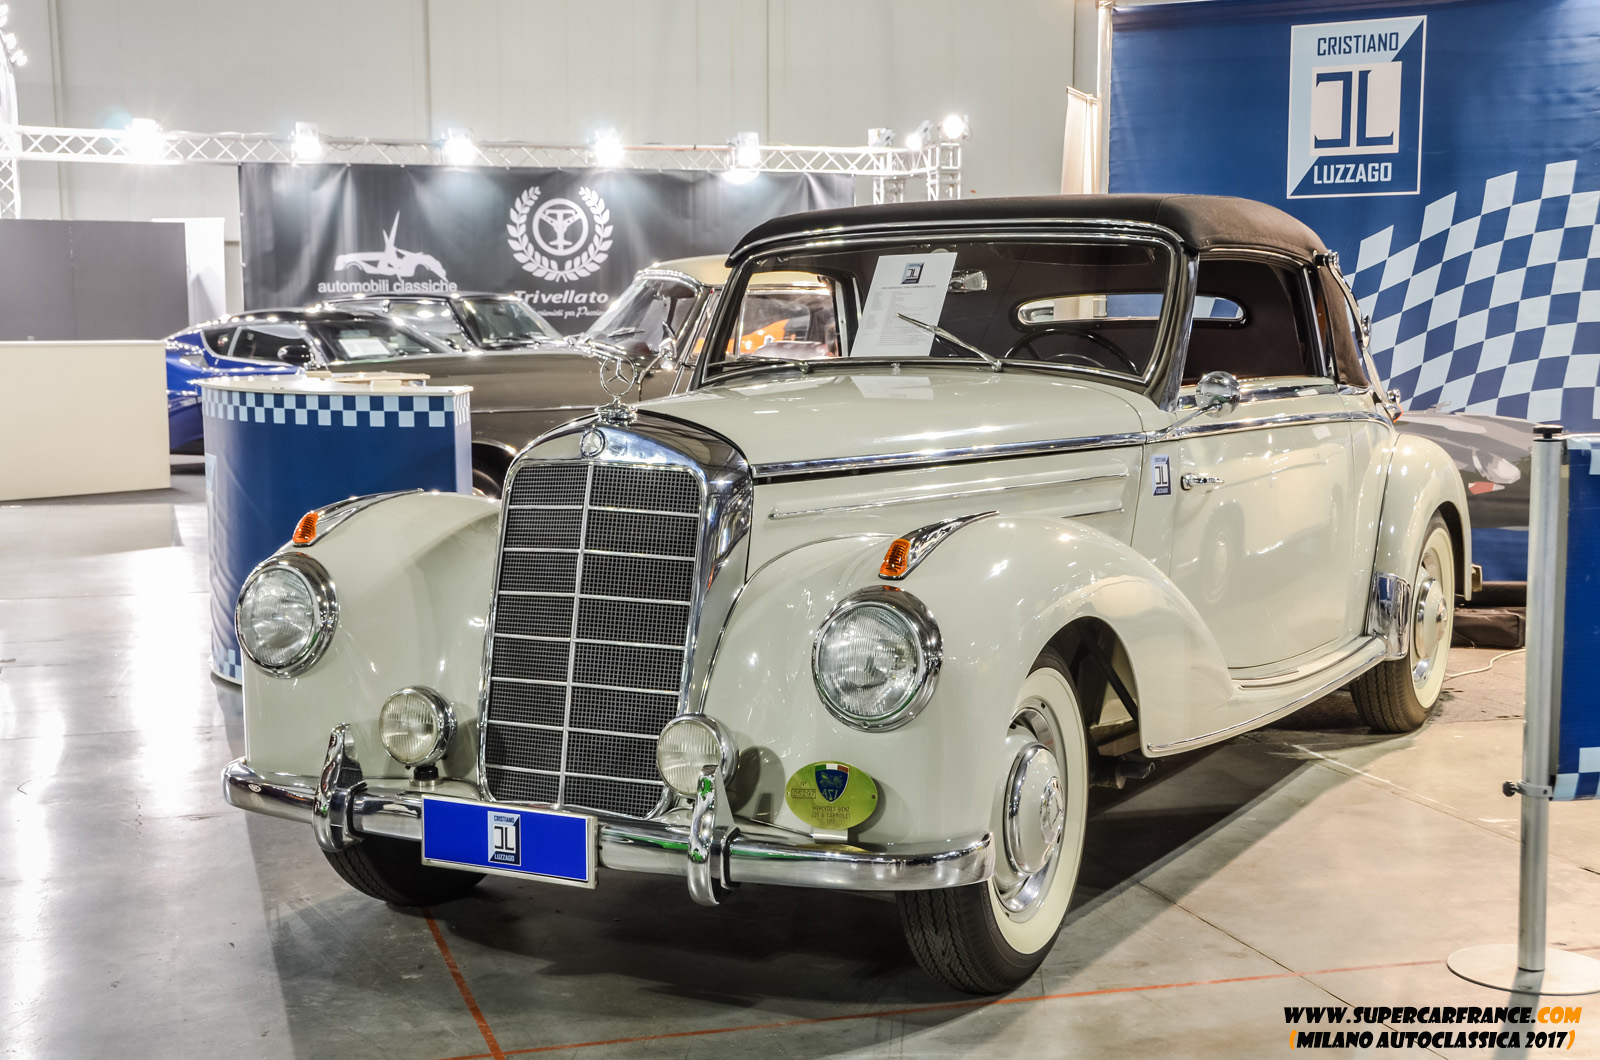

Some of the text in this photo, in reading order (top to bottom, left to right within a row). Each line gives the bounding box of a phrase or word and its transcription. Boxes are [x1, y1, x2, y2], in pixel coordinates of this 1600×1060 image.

[1317, 32, 1399, 56] CRISTIANO
[1313, 162, 1392, 185] LUZZAGO
[318, 279, 458, 293] automobili classiche
[514, 290, 609, 304] Trivellato
[494, 815, 515, 823] CRISTIANO
[494, 853, 515, 862] LUZZAGO
